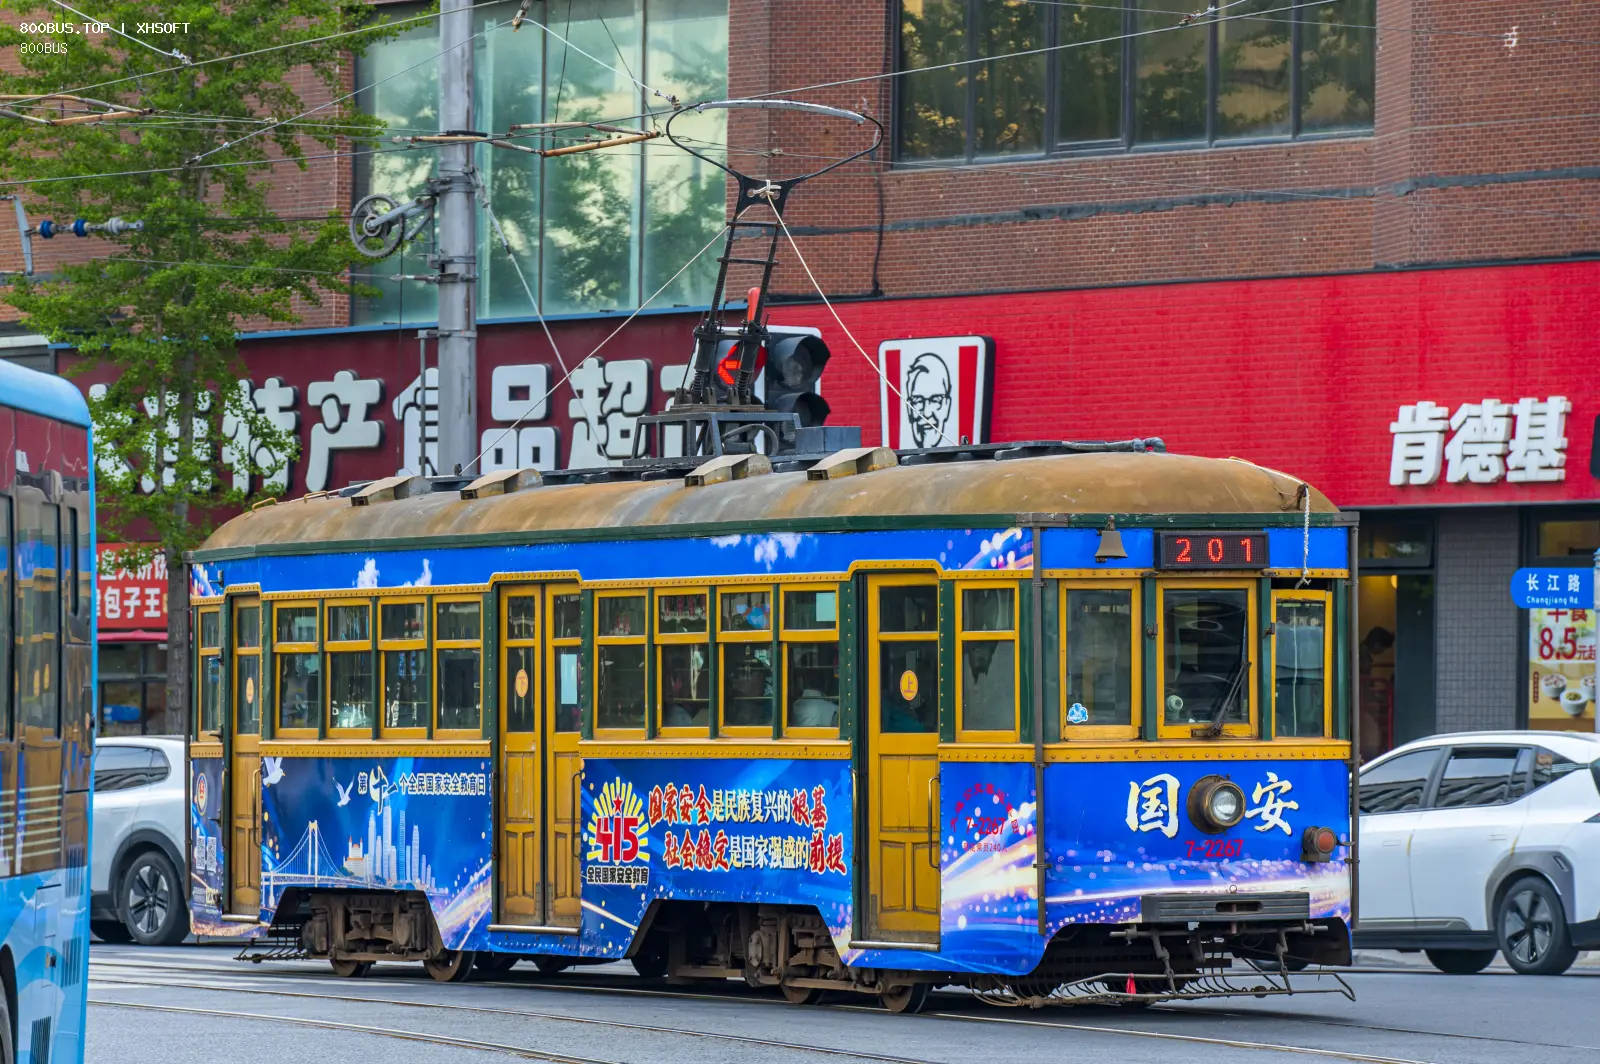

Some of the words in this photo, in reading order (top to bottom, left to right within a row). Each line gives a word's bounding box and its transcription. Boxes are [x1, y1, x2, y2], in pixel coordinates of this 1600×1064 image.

[1389, 396, 1572, 486] 肯德基
[1526, 573, 1580, 593] 长江路
[96, 586, 161, 619] 包子王
[1526, 596, 1567, 605] Changjiang
[904, 676, 915, 693] 上
[648, 783, 828, 830] 国家安全是民族复兴的根基
[966, 817, 1006, 835] 7-2267
[595, 816, 640, 863] 415
[662, 828, 847, 875] 社会稳定是国家强盛的前提
[1185, 839, 1244, 858] 7-2267
